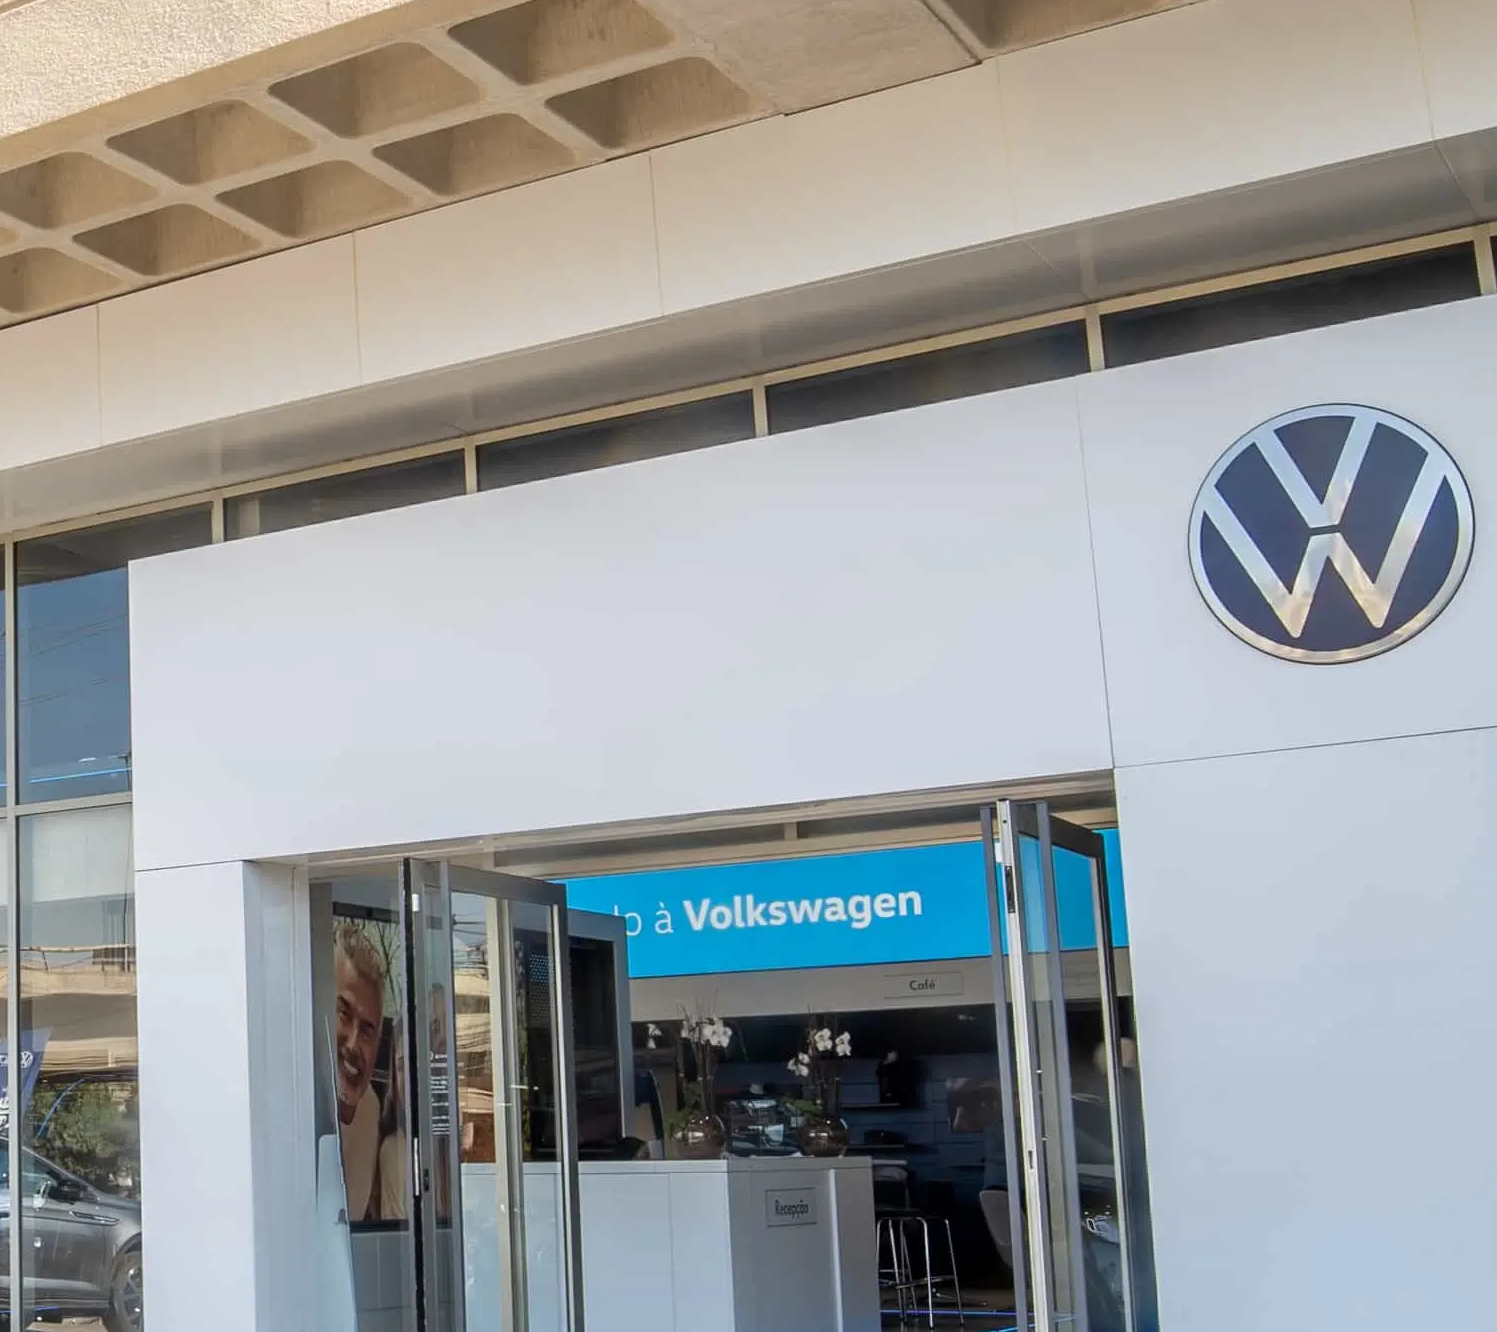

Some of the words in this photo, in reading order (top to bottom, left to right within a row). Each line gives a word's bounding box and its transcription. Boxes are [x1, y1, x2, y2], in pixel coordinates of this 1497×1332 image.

[654, 901, 674, 934] à
[683, 889, 922, 932] Volkswagen
[909, 977, 936, 991] Café
